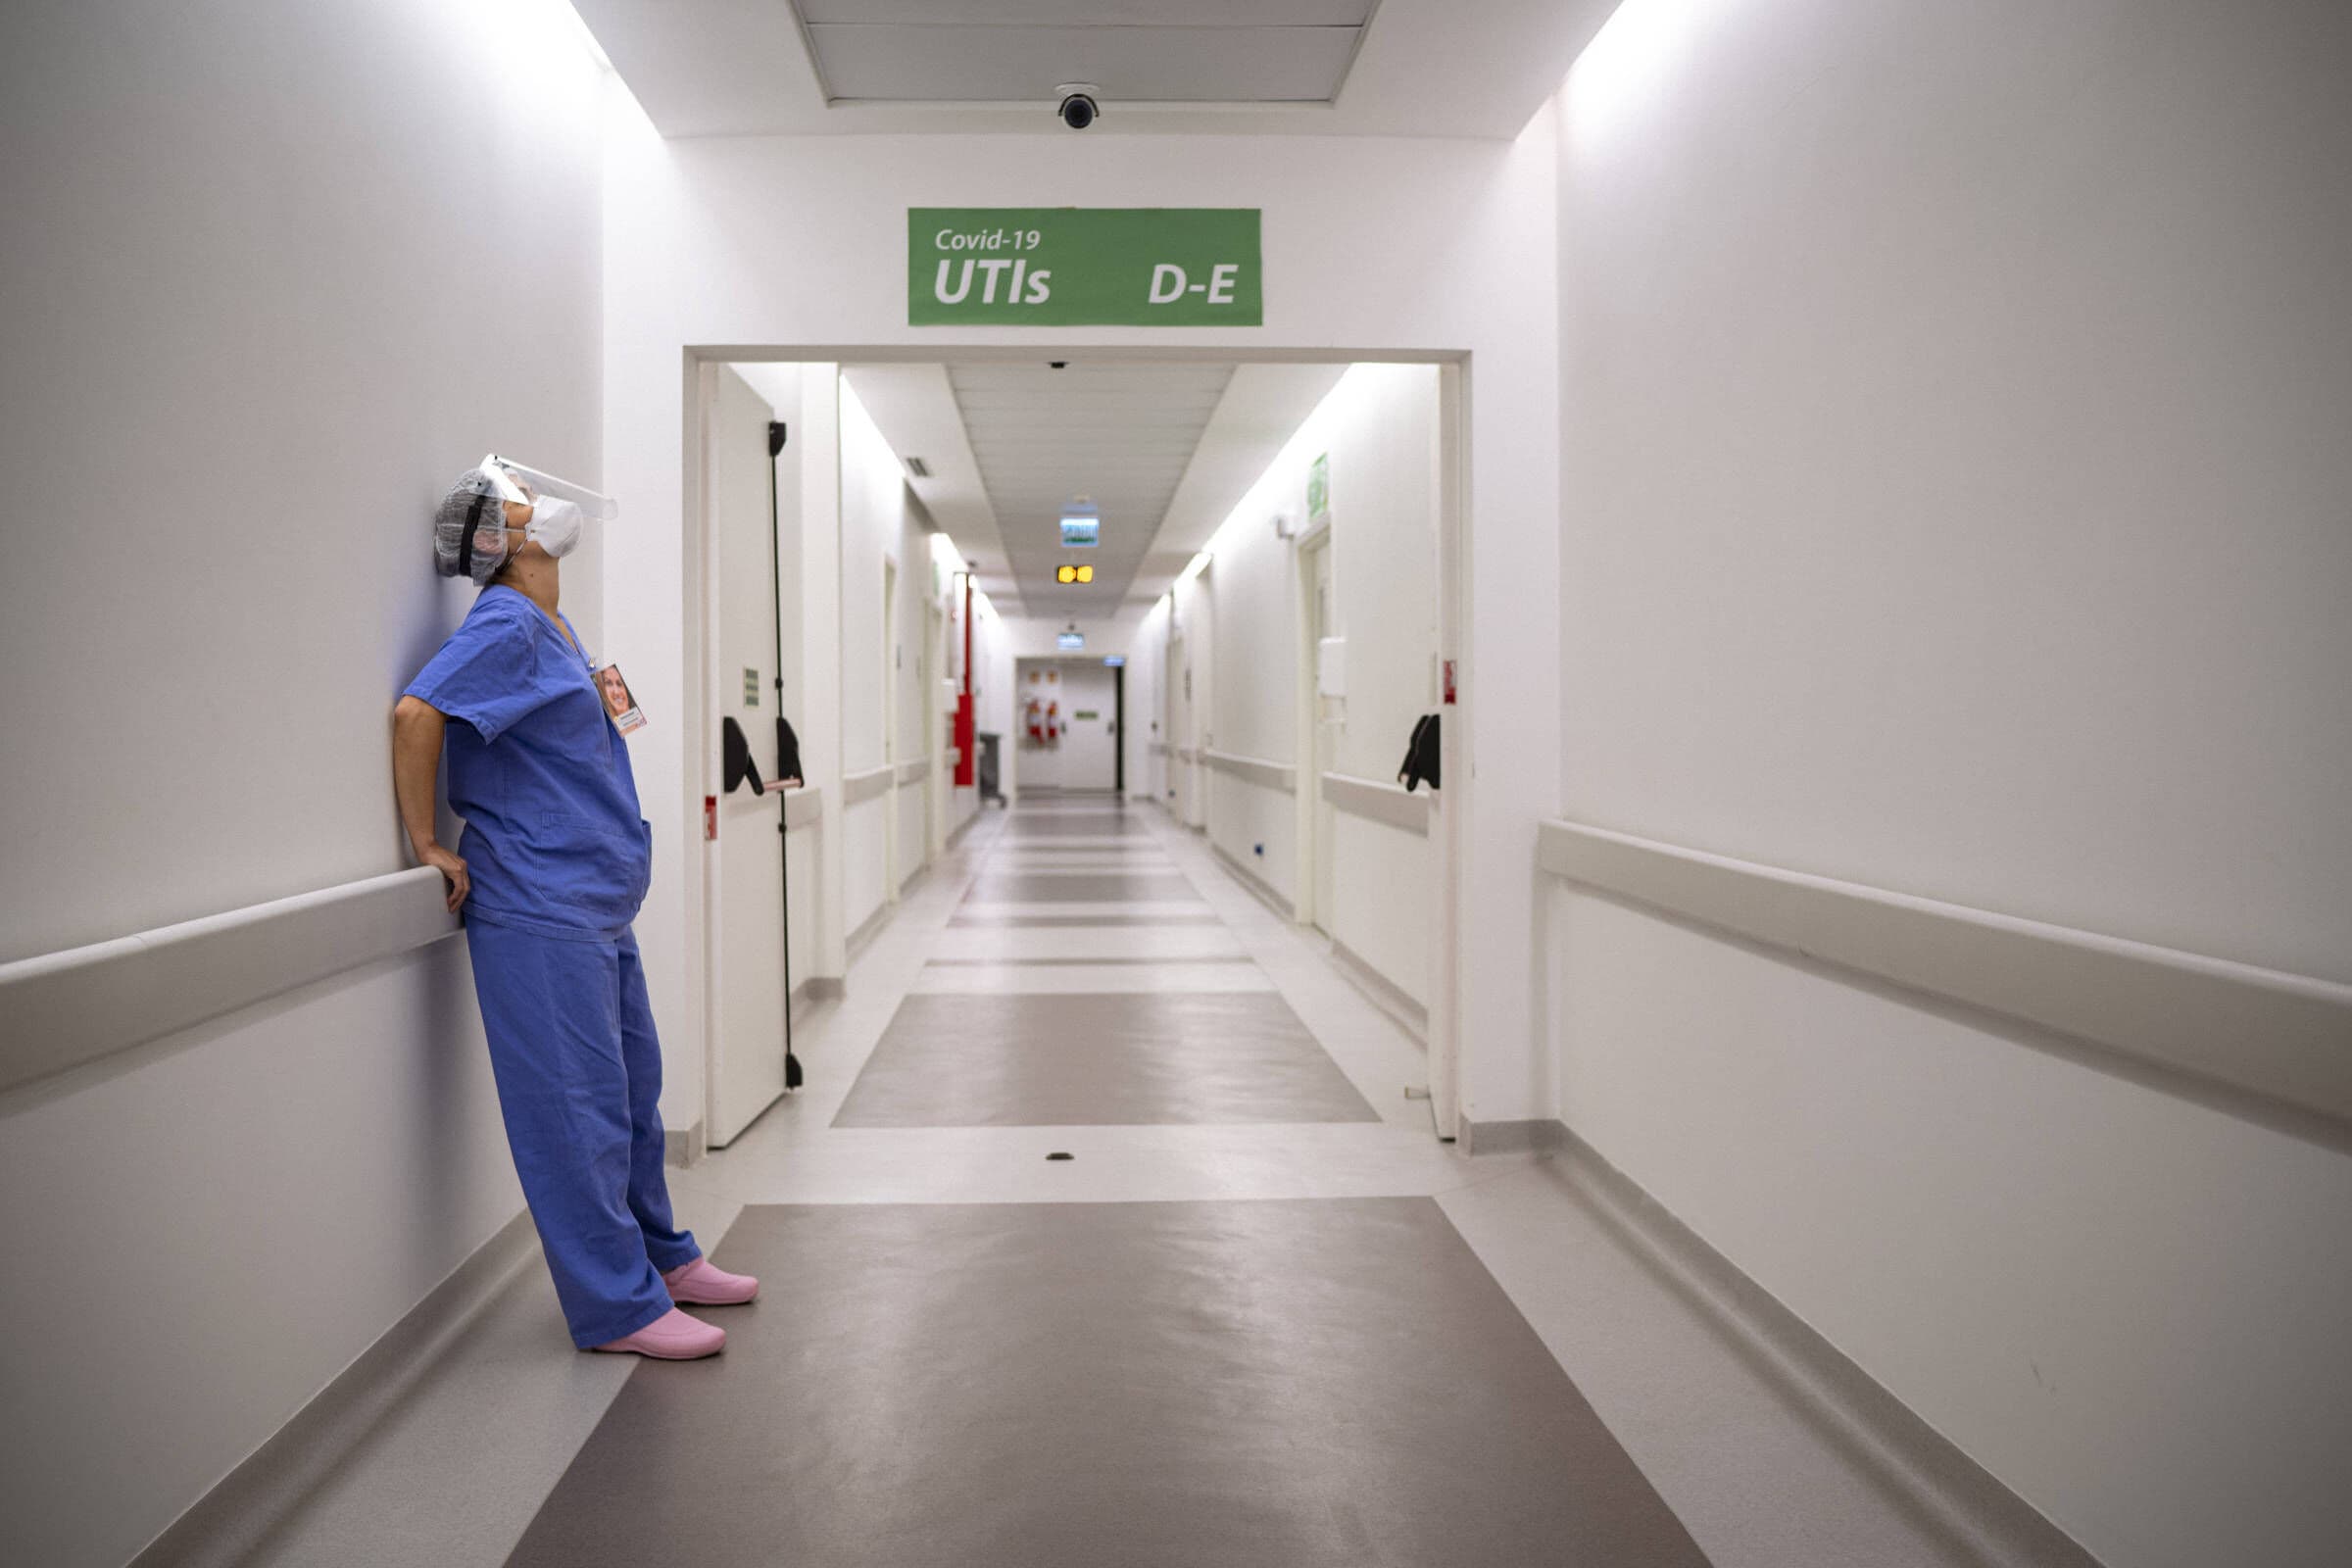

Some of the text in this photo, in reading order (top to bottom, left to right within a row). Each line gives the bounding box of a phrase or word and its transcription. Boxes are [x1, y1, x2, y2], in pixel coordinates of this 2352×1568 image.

[935, 228, 1041, 251] Covid-19
[934, 259, 1240, 305] UTIs D-E
